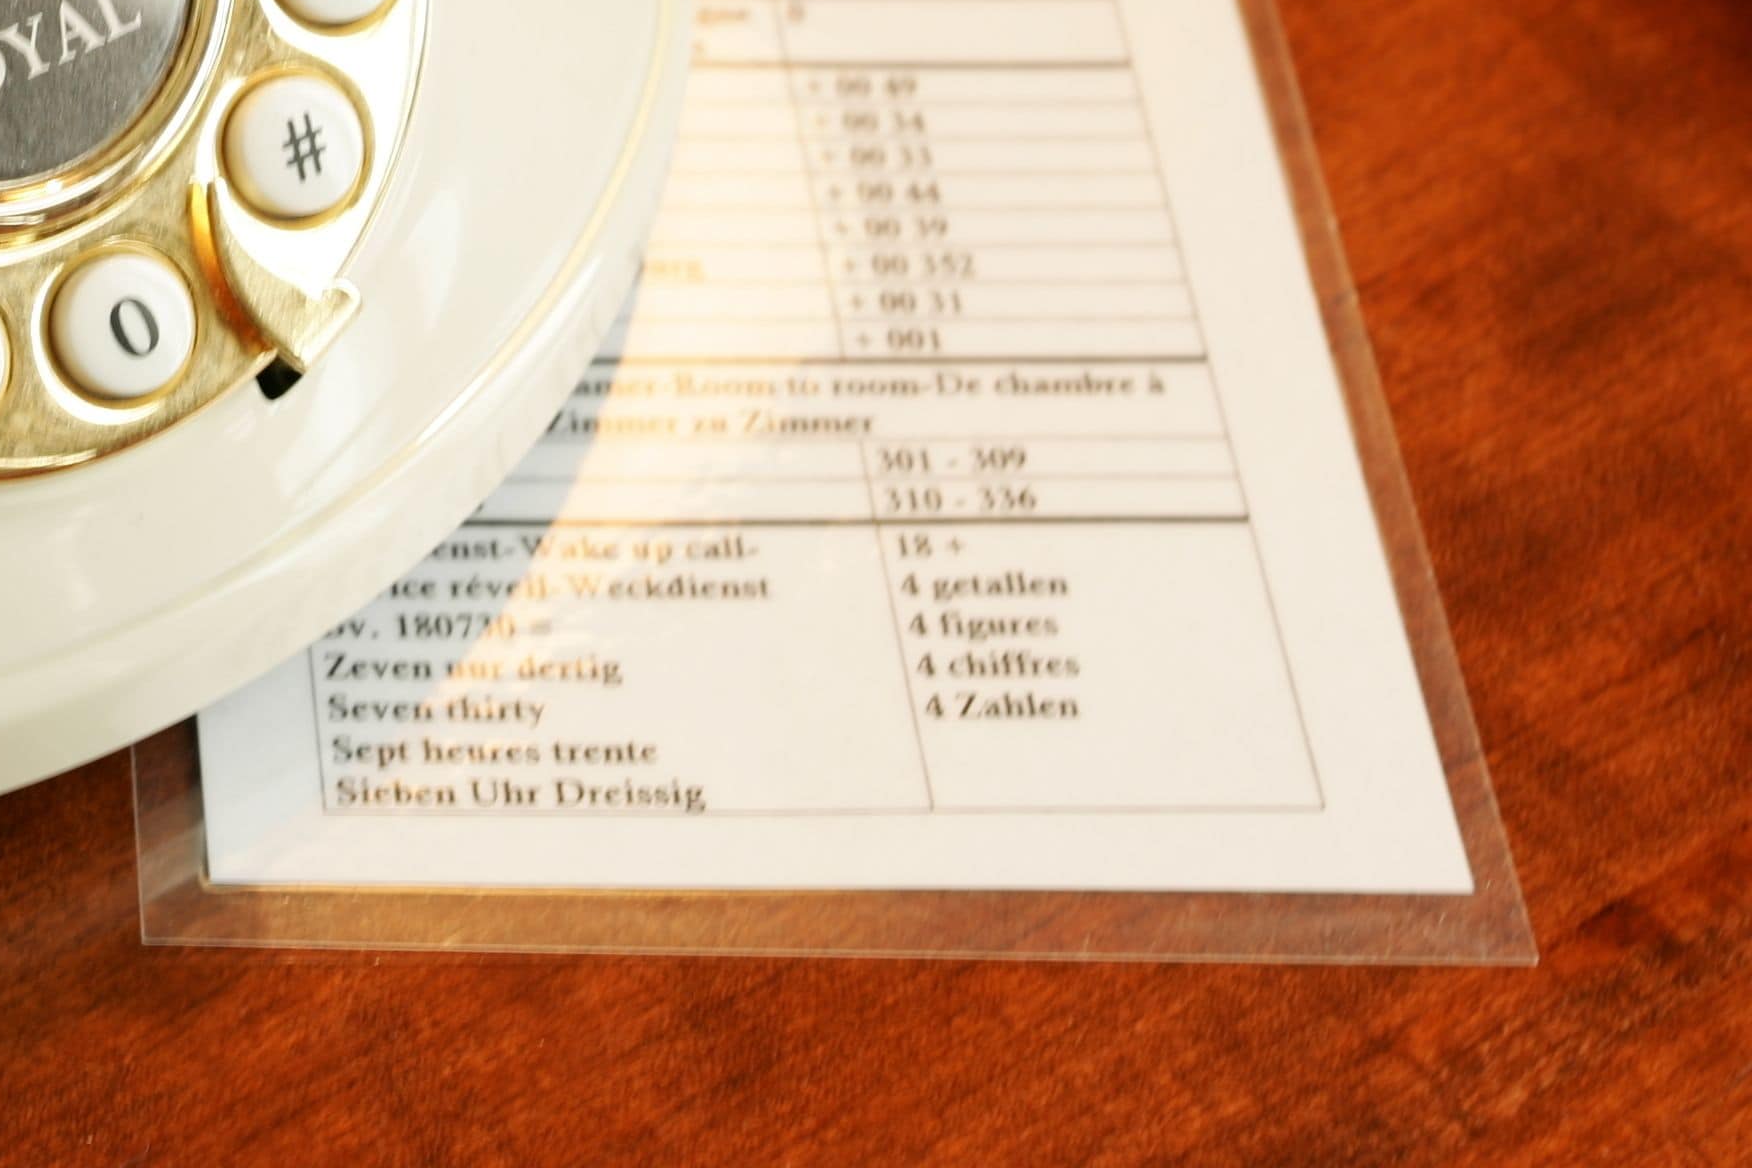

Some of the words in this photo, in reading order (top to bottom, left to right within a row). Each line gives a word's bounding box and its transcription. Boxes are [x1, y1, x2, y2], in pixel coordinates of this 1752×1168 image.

[109, 295, 159, 359] 0
[574, 372, 777, 397] amer-Room
[785, 374, 821, 397] to
[994, 371, 1135, 396] chambre
[693, 414, 728, 434] zu
[743, 409, 874, 434] Zimmer
[877, 447, 932, 473] 301
[971, 445, 1027, 472] 309
[884, 486, 943, 512] 310
[978, 486, 1038, 511] 336
[632, 539, 673, 567] up
[898, 533, 932, 558] 18
[901, 572, 920, 597] 4
[933, 570, 1069, 602] getallen
[909, 612, 928, 636] 4
[940, 610, 1060, 642] figures
[323, 652, 432, 681] Zeven
[446, 659, 503, 680] uur
[517, 654, 624, 686] dertig
[917, 652, 936, 677] 4
[948, 650, 1082, 677] chiffres
[328, 694, 433, 723] Seven
[446, 695, 546, 728] thirty
[925, 692, 945, 718] 4
[954, 691, 1079, 719] Zahlen
[332, 736, 411, 771] Sept
[423, 736, 542, 766] heures
[552, 738, 659, 766] trente
[336, 778, 456, 808] Sieben
[471, 778, 542, 808] Uhr
[554, 778, 707, 814] Dreissig
